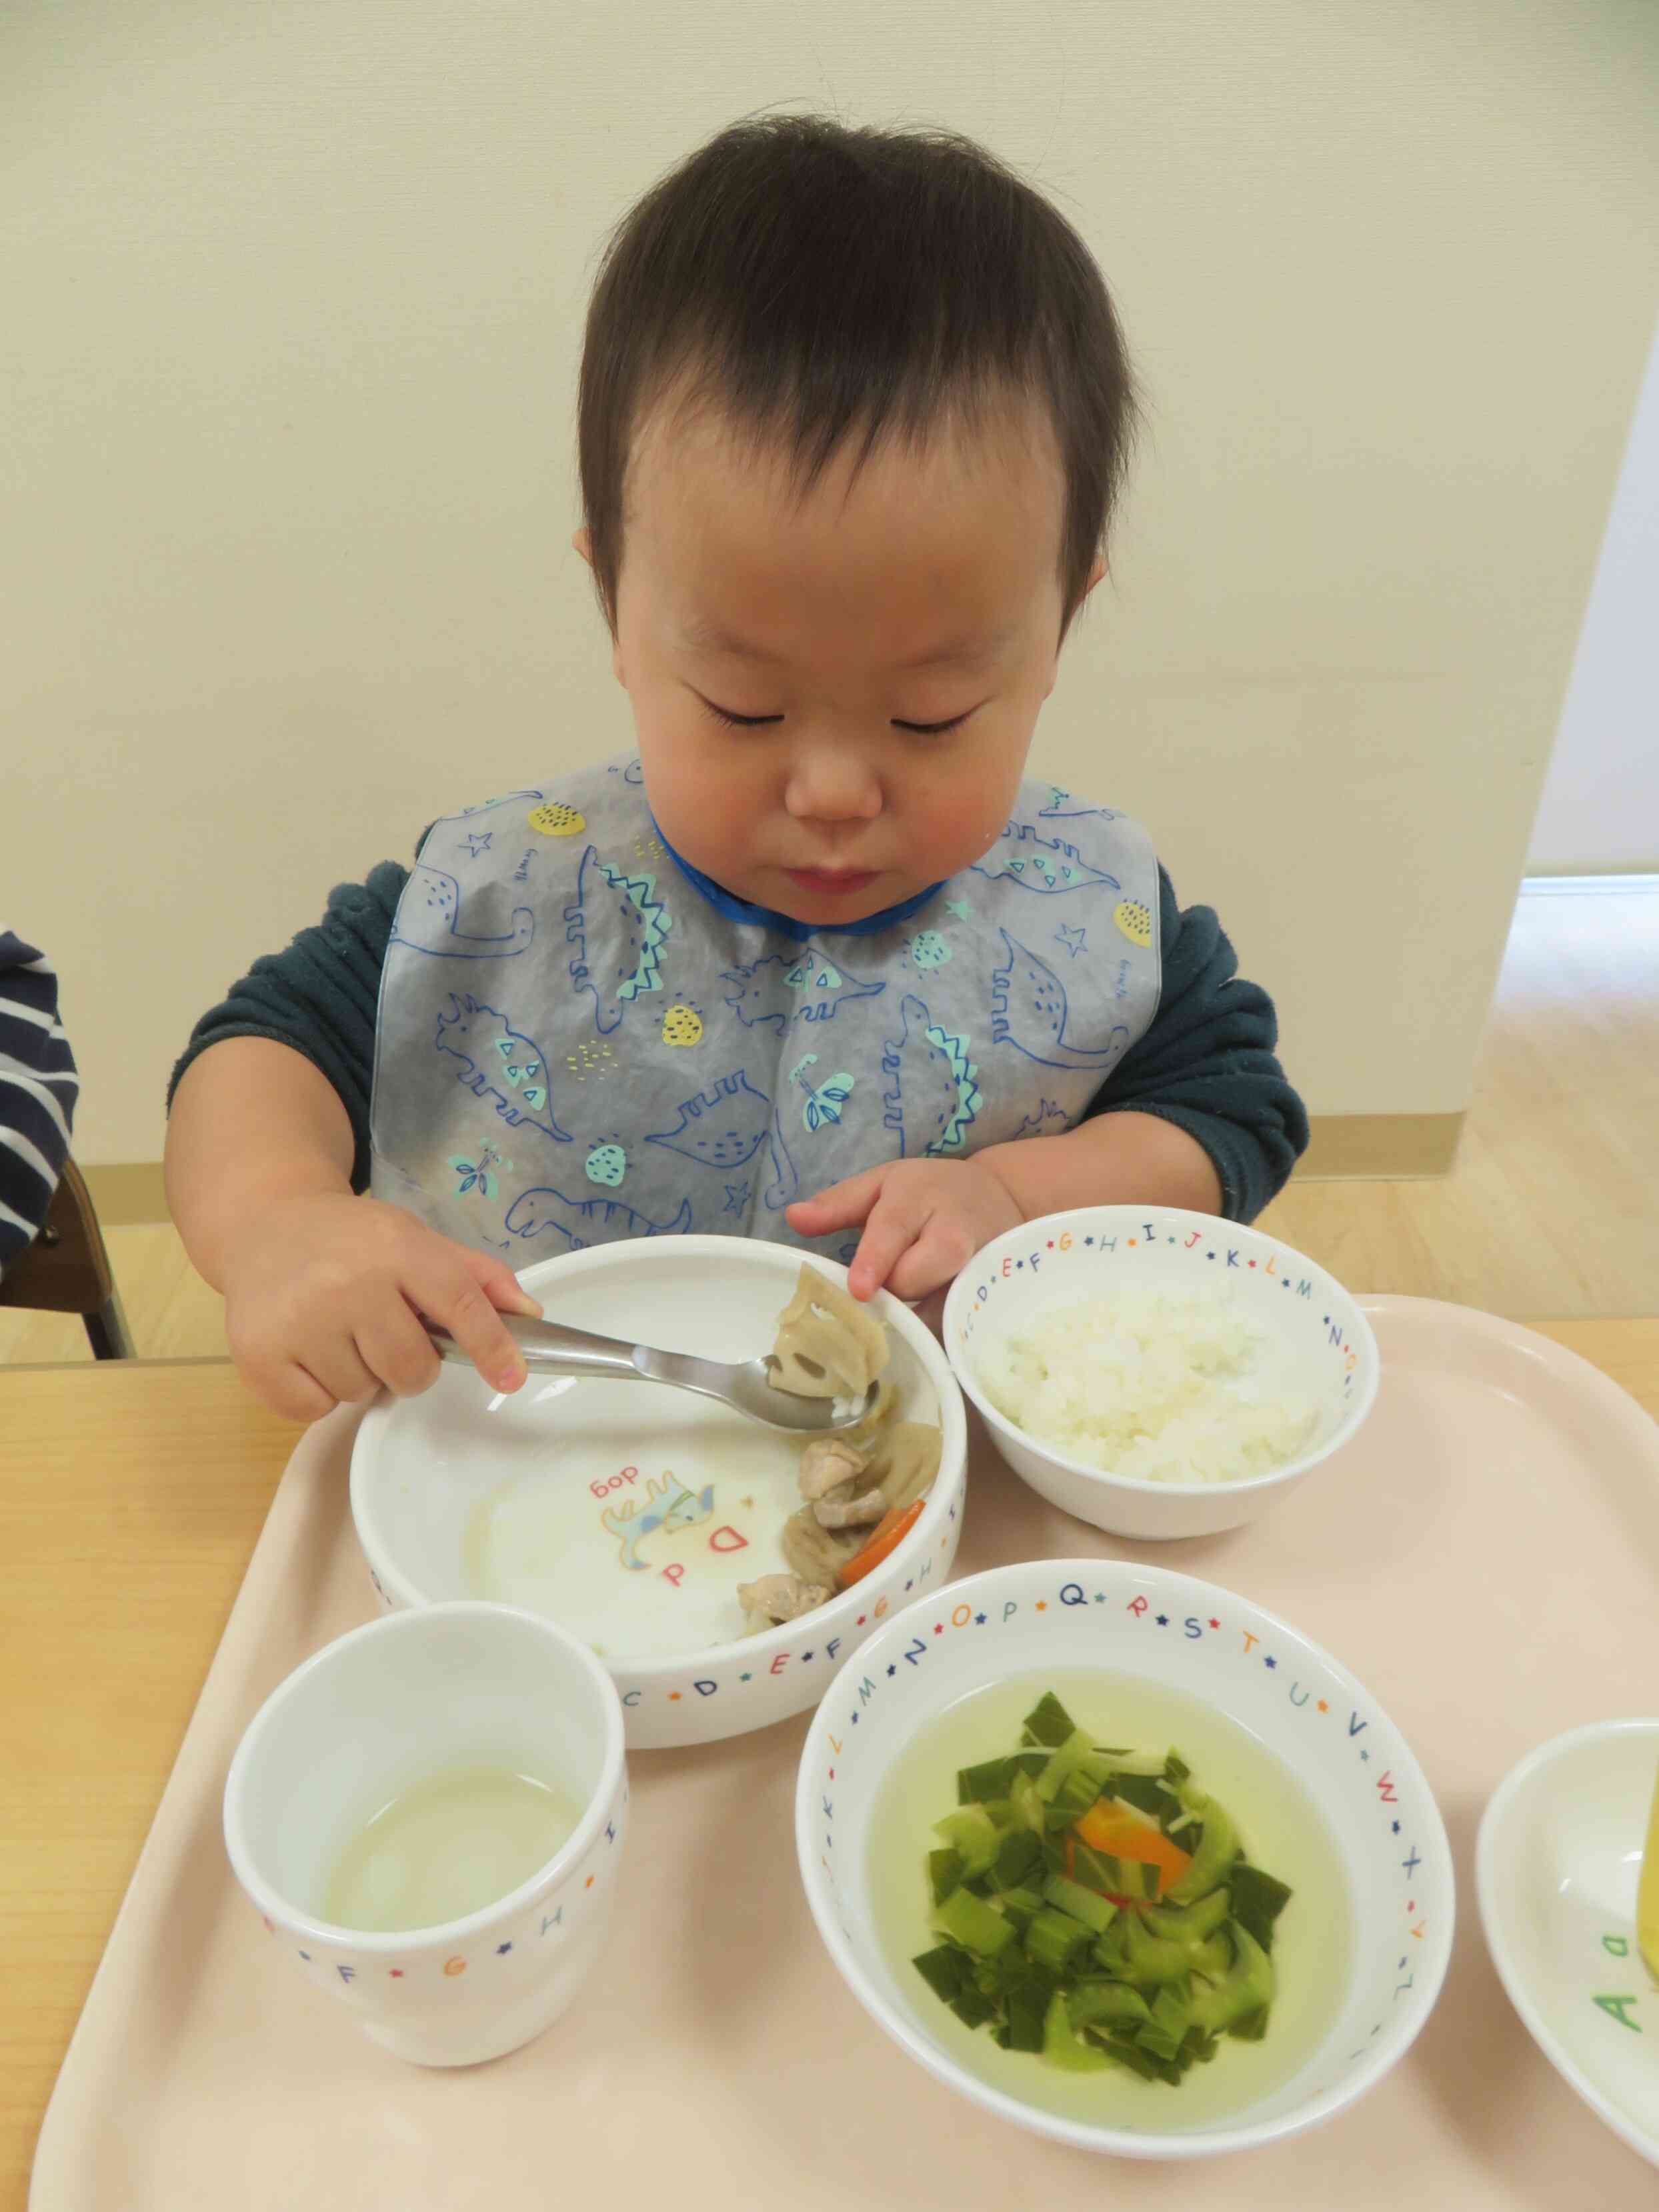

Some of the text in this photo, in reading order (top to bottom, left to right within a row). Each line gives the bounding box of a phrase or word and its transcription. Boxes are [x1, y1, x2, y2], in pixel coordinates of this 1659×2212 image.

[977, 1285, 988, 1302] D
[1002, 1258, 1013, 1277] E
[1029, 1253, 1041, 1271] F
[1058, 1232, 1073, 1251] G
[1100, 1236, 1116, 1253] H
[1142, 1224, 1156, 1241] I
[1184, 1231, 1202, 1249] J
[1227, 1250, 1240, 1267] K
[1266, 1257, 1276, 1275] L
[1296, 1281, 1312, 1299] M
[1328, 1324, 1343, 1347] N
[590, 1466, 638, 1499] dog
[709, 1525, 748, 1553] D
[623, 1691, 642, 1707] C
[694, 1680, 718, 1697] D
[769, 1653, 790, 1675] E
[826, 1637, 842, 1659] F
[874, 1595, 888, 1619] G
[827, 1733, 843, 1755] L
[858, 1677, 877, 1706] M
[904, 1638, 927, 1665] N
[951, 1603, 972, 1627] O
[1003, 1601, 1018, 1623] P
[1059, 1583, 1088, 1606] Q
[1126, 1595, 1148, 1618] R
[1184, 1617, 1202, 1639] S
[1242, 1631, 1260, 1653] T
[1289, 1682, 1310, 1707] U
[1349, 1711, 1368, 1736] V
[1376, 1771, 1398, 1803] W
[1402, 1845, 1422, 1880] X
[337, 1965, 356, 1984] F
[443, 1956, 466, 1977] G
[540, 1905, 563, 1936] H
[1591, 1935, 1643, 2034] A a
